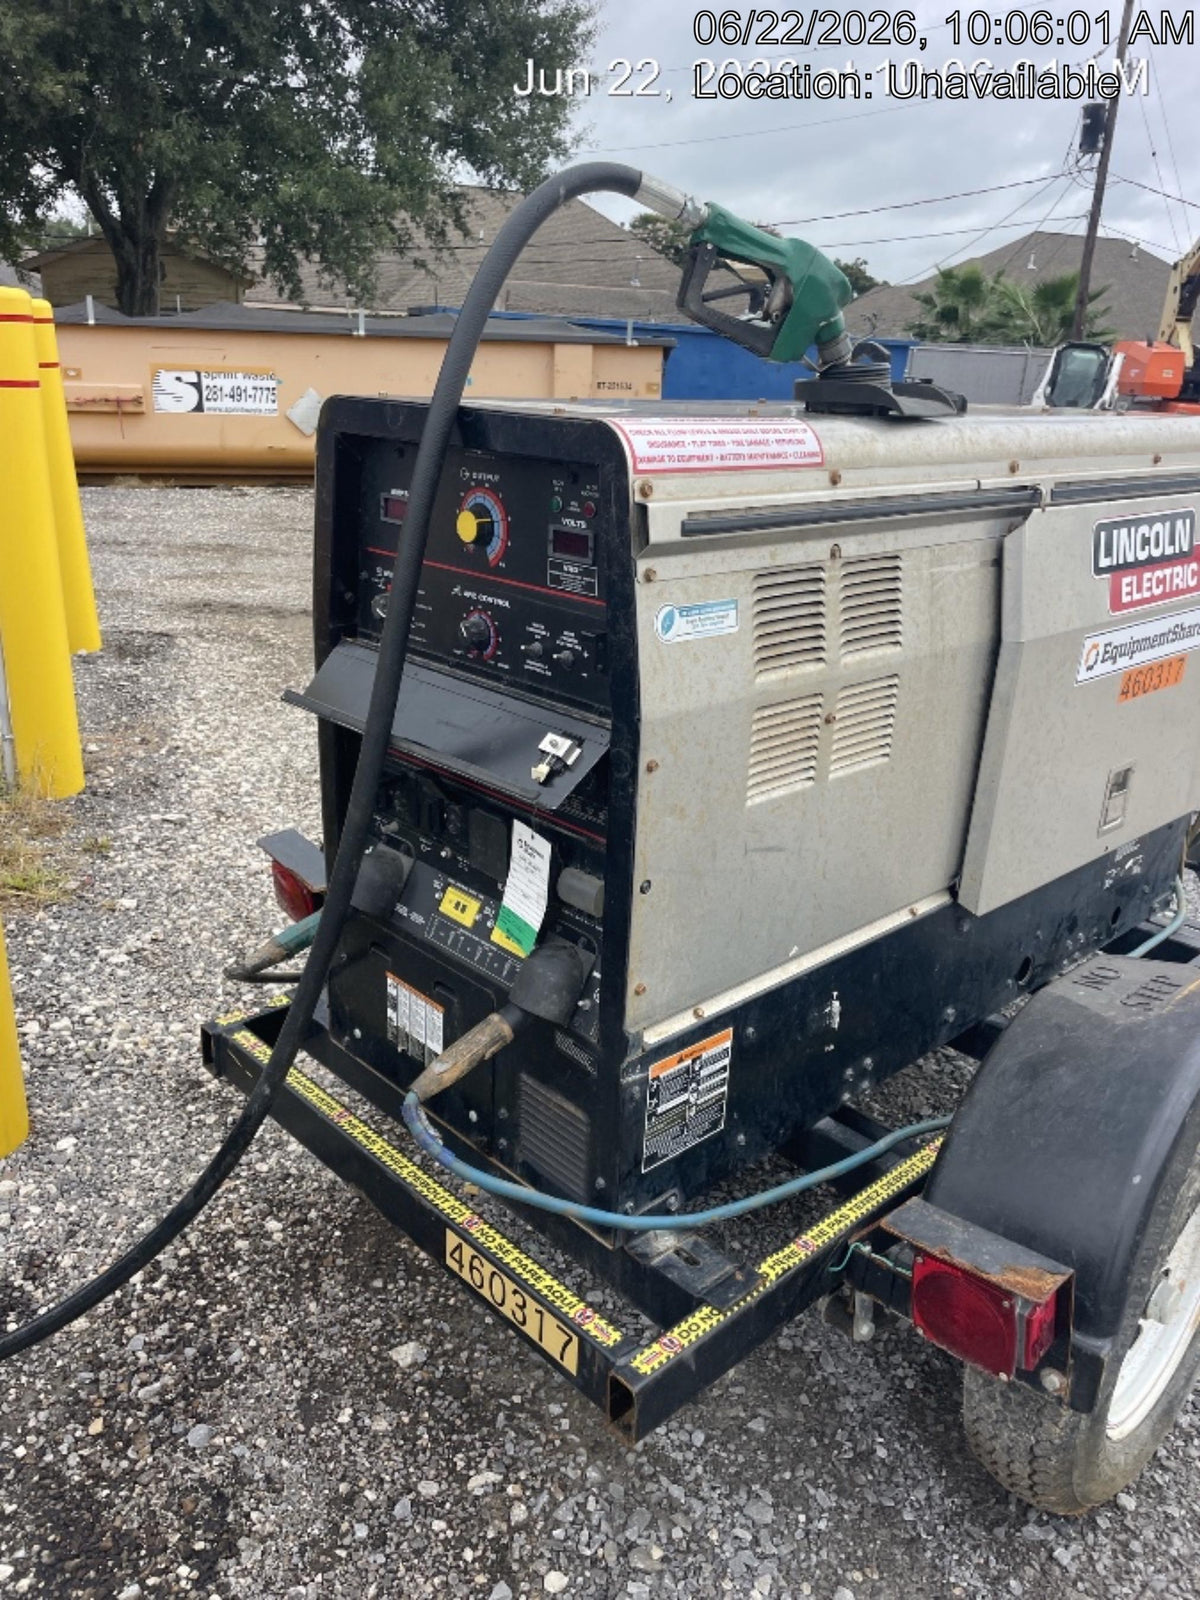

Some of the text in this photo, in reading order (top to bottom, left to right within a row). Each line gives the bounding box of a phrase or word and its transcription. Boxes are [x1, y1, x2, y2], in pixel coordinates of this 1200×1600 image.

[204, 385, 277, 404] 281-491-7775
[561, 516, 588, 529] VOLTS
[1097, 518, 1191, 568] LINCOLN
[1121, 562, 1199, 604] ELECTRIC
[1119, 656, 1186, 700] 460317
[1071, 966, 1121, 991] NO
[1119, 974, 1183, 1012] STEP
[475, 1227, 497, 1244] NO
[494, 1241, 513, 1257] SE
[511, 1256, 546, 1284] PARE
[448, 1241, 574, 1363] 460317
[677, 1322, 702, 1340] DO
